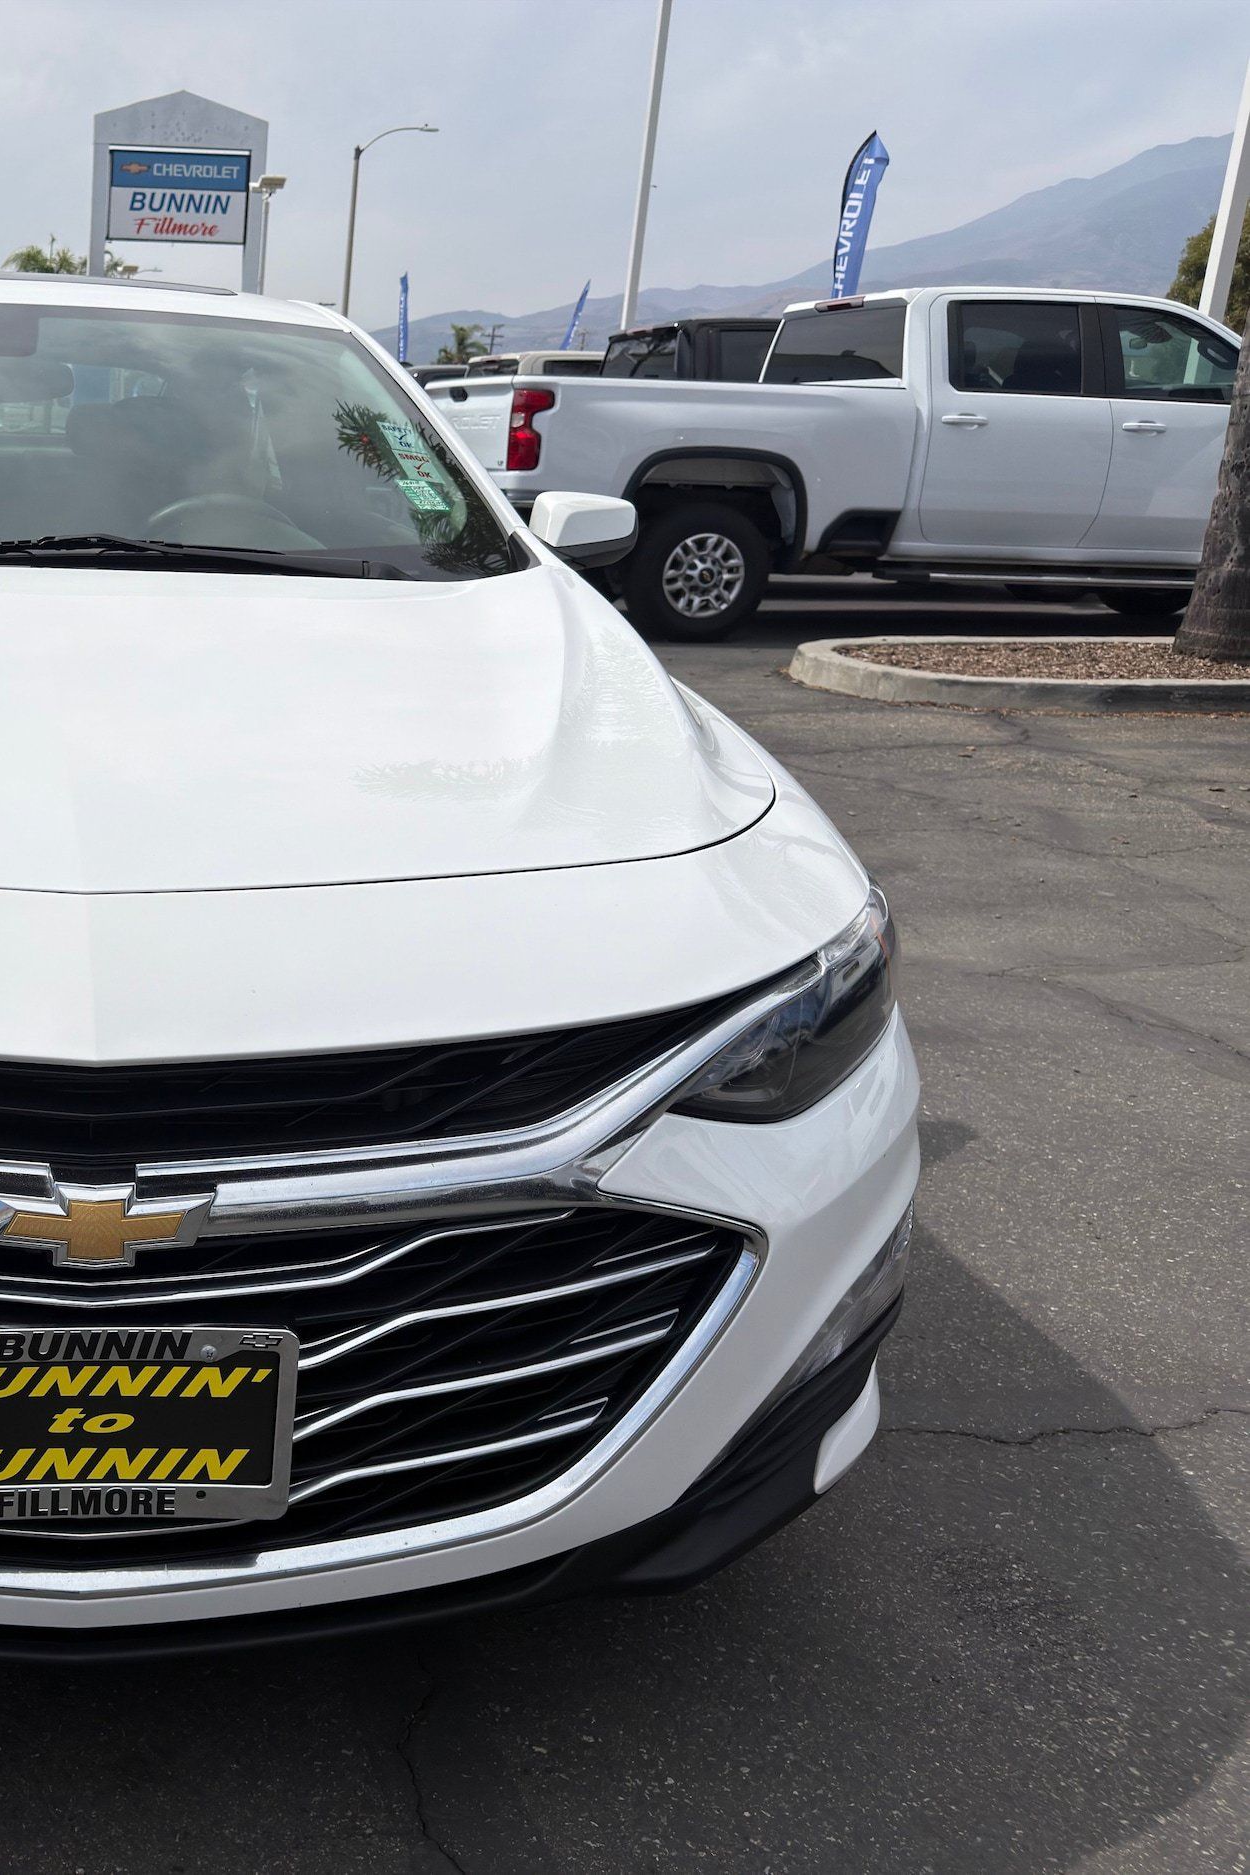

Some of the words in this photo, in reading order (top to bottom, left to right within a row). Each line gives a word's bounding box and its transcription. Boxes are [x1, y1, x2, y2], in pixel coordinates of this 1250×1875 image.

[152, 163, 240, 179] CHEVROLET
[129, 192, 231, 214] BUNNIN
[134, 217, 219, 237] Fillmore
[48, 1408, 135, 1434] to
